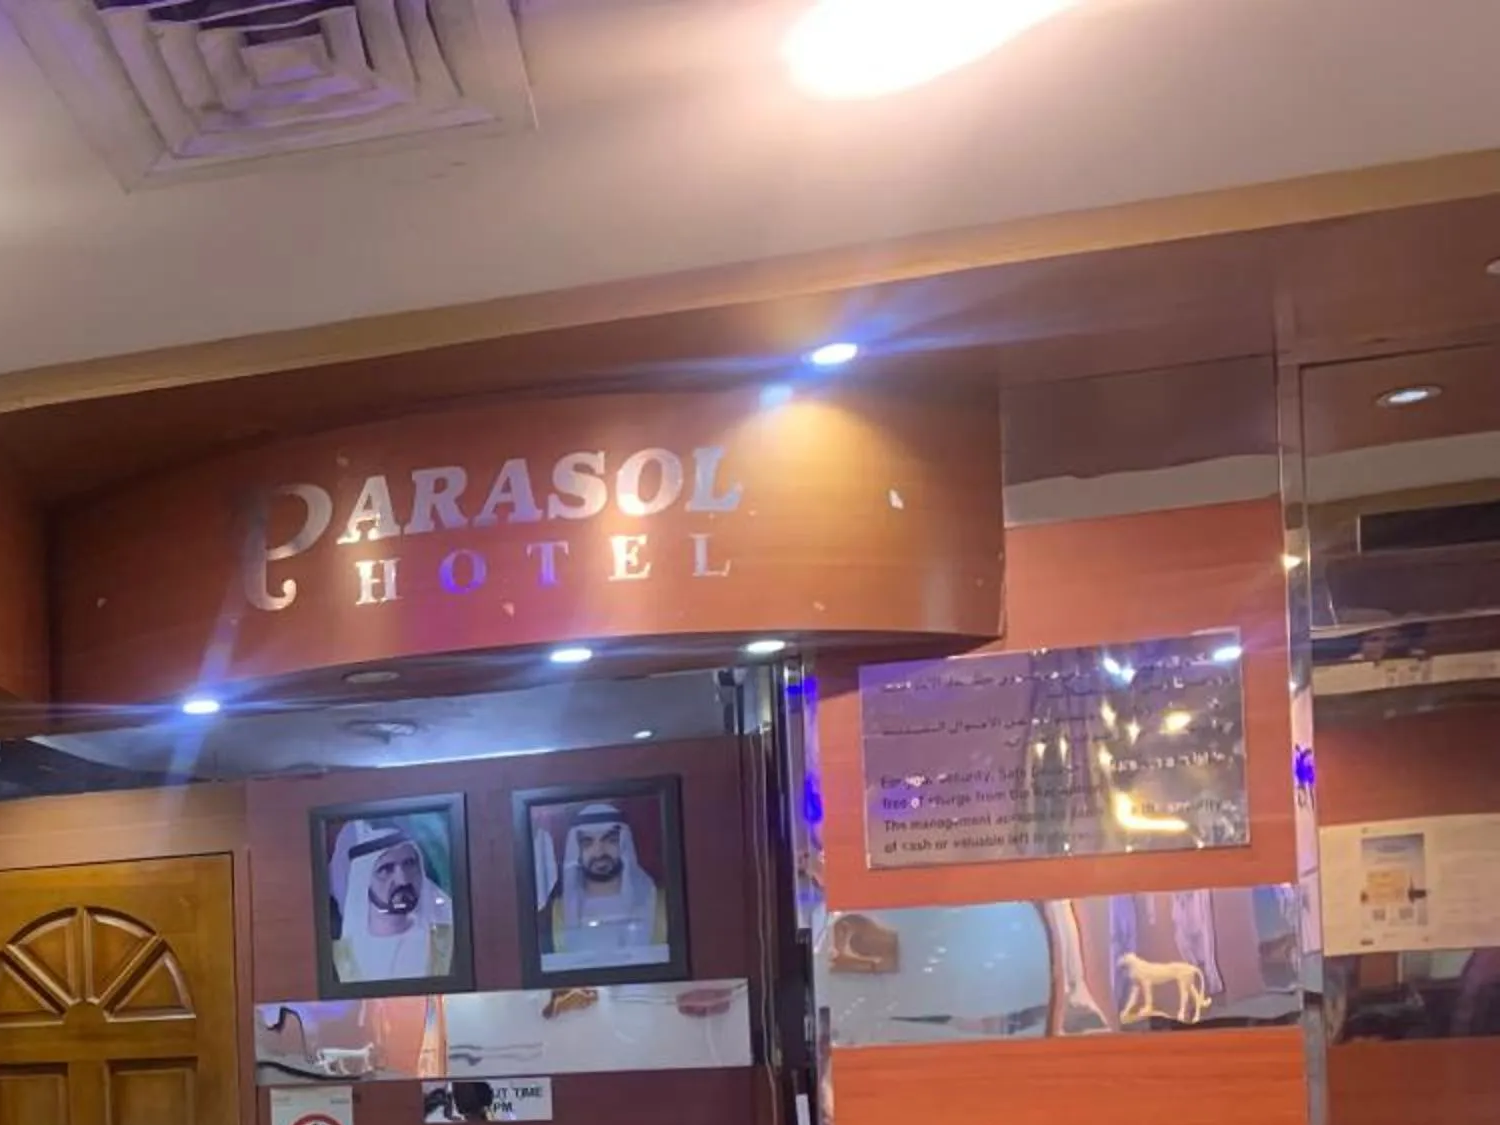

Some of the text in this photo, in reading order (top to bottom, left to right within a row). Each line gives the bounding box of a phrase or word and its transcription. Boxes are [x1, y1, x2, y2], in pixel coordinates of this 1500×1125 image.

[244, 446, 742, 612] PARASOL
[354, 532, 732, 606] HOTEL
[884, 818, 907, 833] The
[884, 839, 898, 854] of
[512, 1085, 543, 1099] TIME
